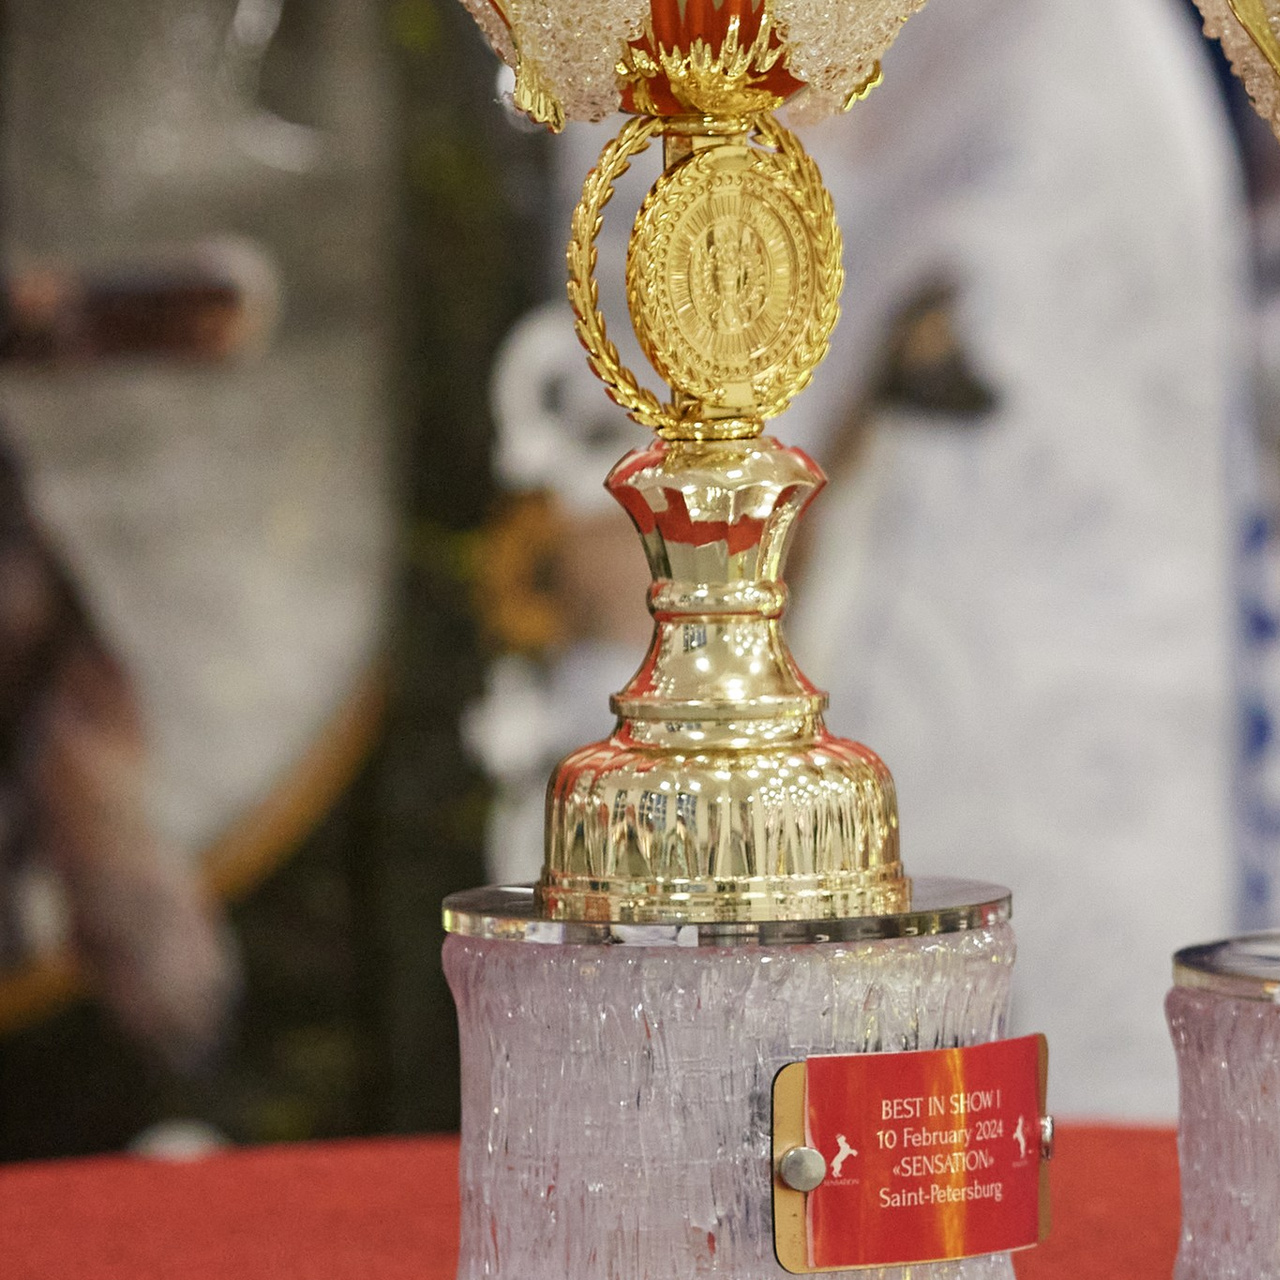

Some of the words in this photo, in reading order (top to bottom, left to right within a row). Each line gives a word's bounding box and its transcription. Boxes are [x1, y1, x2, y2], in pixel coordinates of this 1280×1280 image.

[881, 1097, 923, 1120] BEST
[928, 1095, 945, 1117] IN
[949, 1090, 994, 1115] SHOW
[996, 1089, 1001, 1108] I
[876, 1129, 897, 1149] 10
[903, 1126, 972, 1148] February
[975, 1119, 1003, 1141] 2024
[892, 1148, 995, 1177] «SENSATION»
[879, 1180, 1003, 1208] Saint-Petersburg
